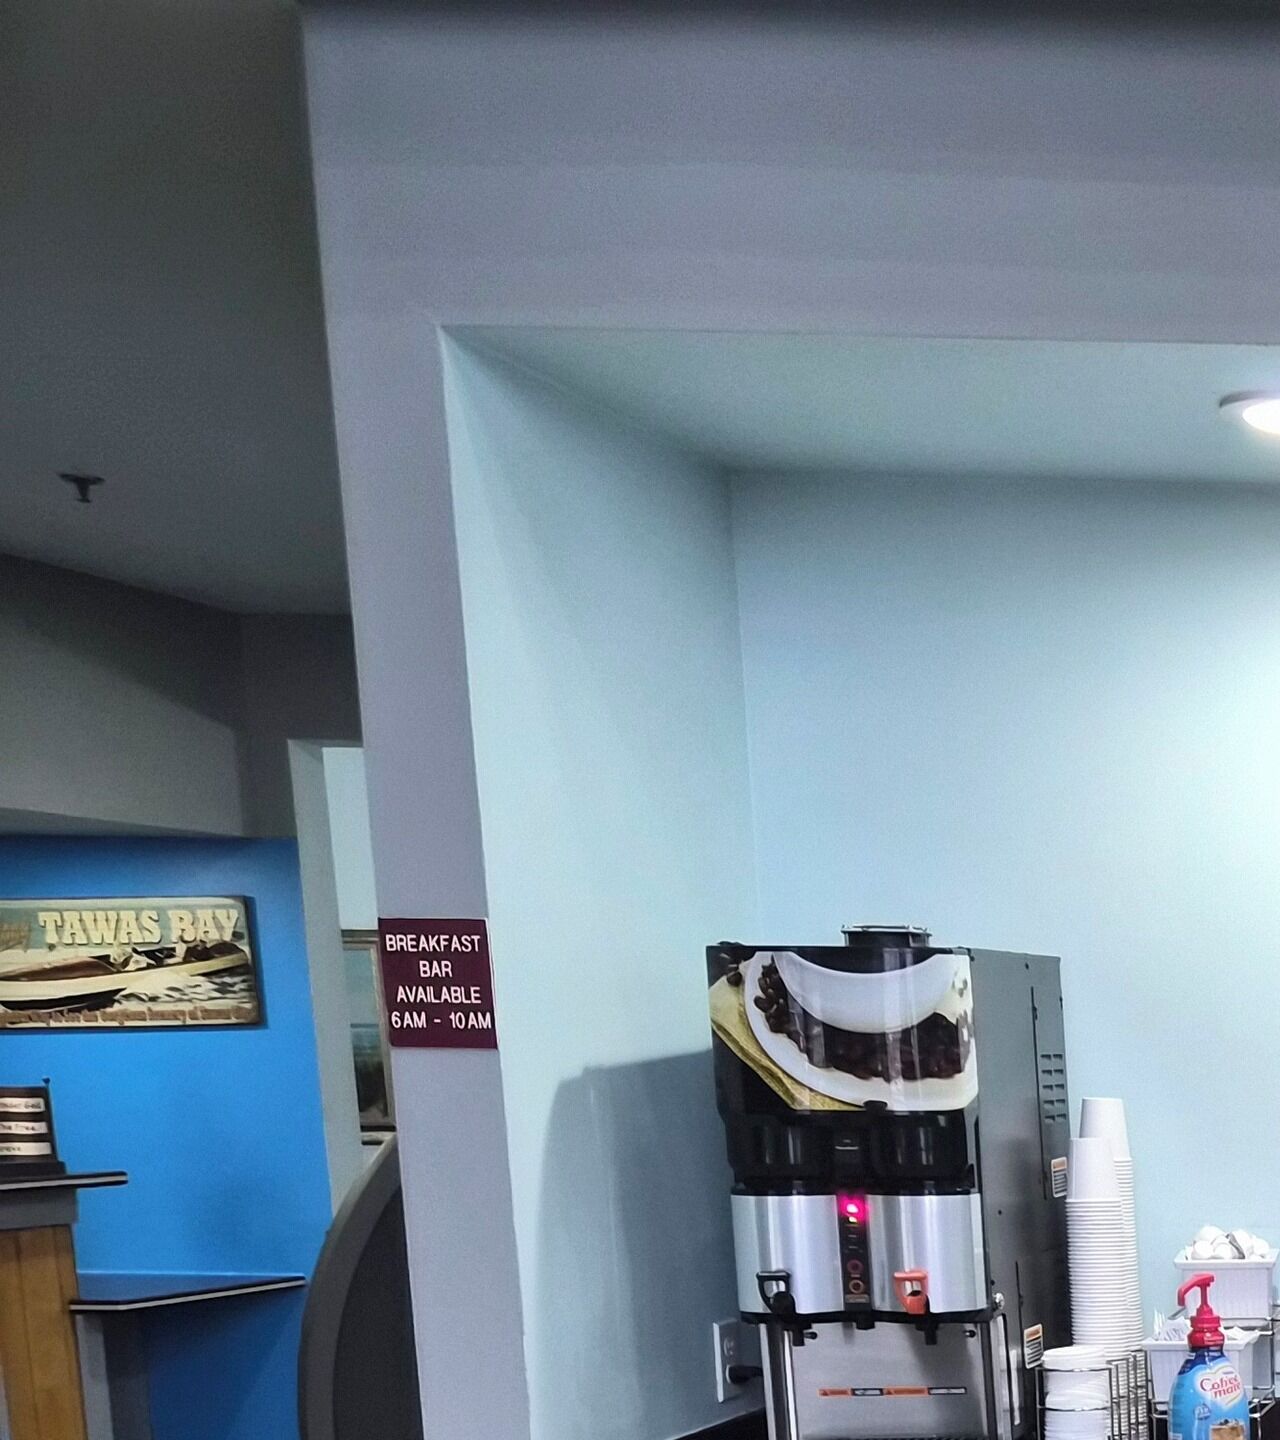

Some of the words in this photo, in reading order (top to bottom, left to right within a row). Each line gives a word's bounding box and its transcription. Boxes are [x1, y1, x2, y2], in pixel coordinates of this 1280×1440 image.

[38, 908, 162, 945] TAWAS
[168, 908, 239, 943] BAY
[385, 934, 481, 952] BREAKFAST
[419, 960, 453, 978] BAR
[397, 986, 482, 1004] AVAILABLE
